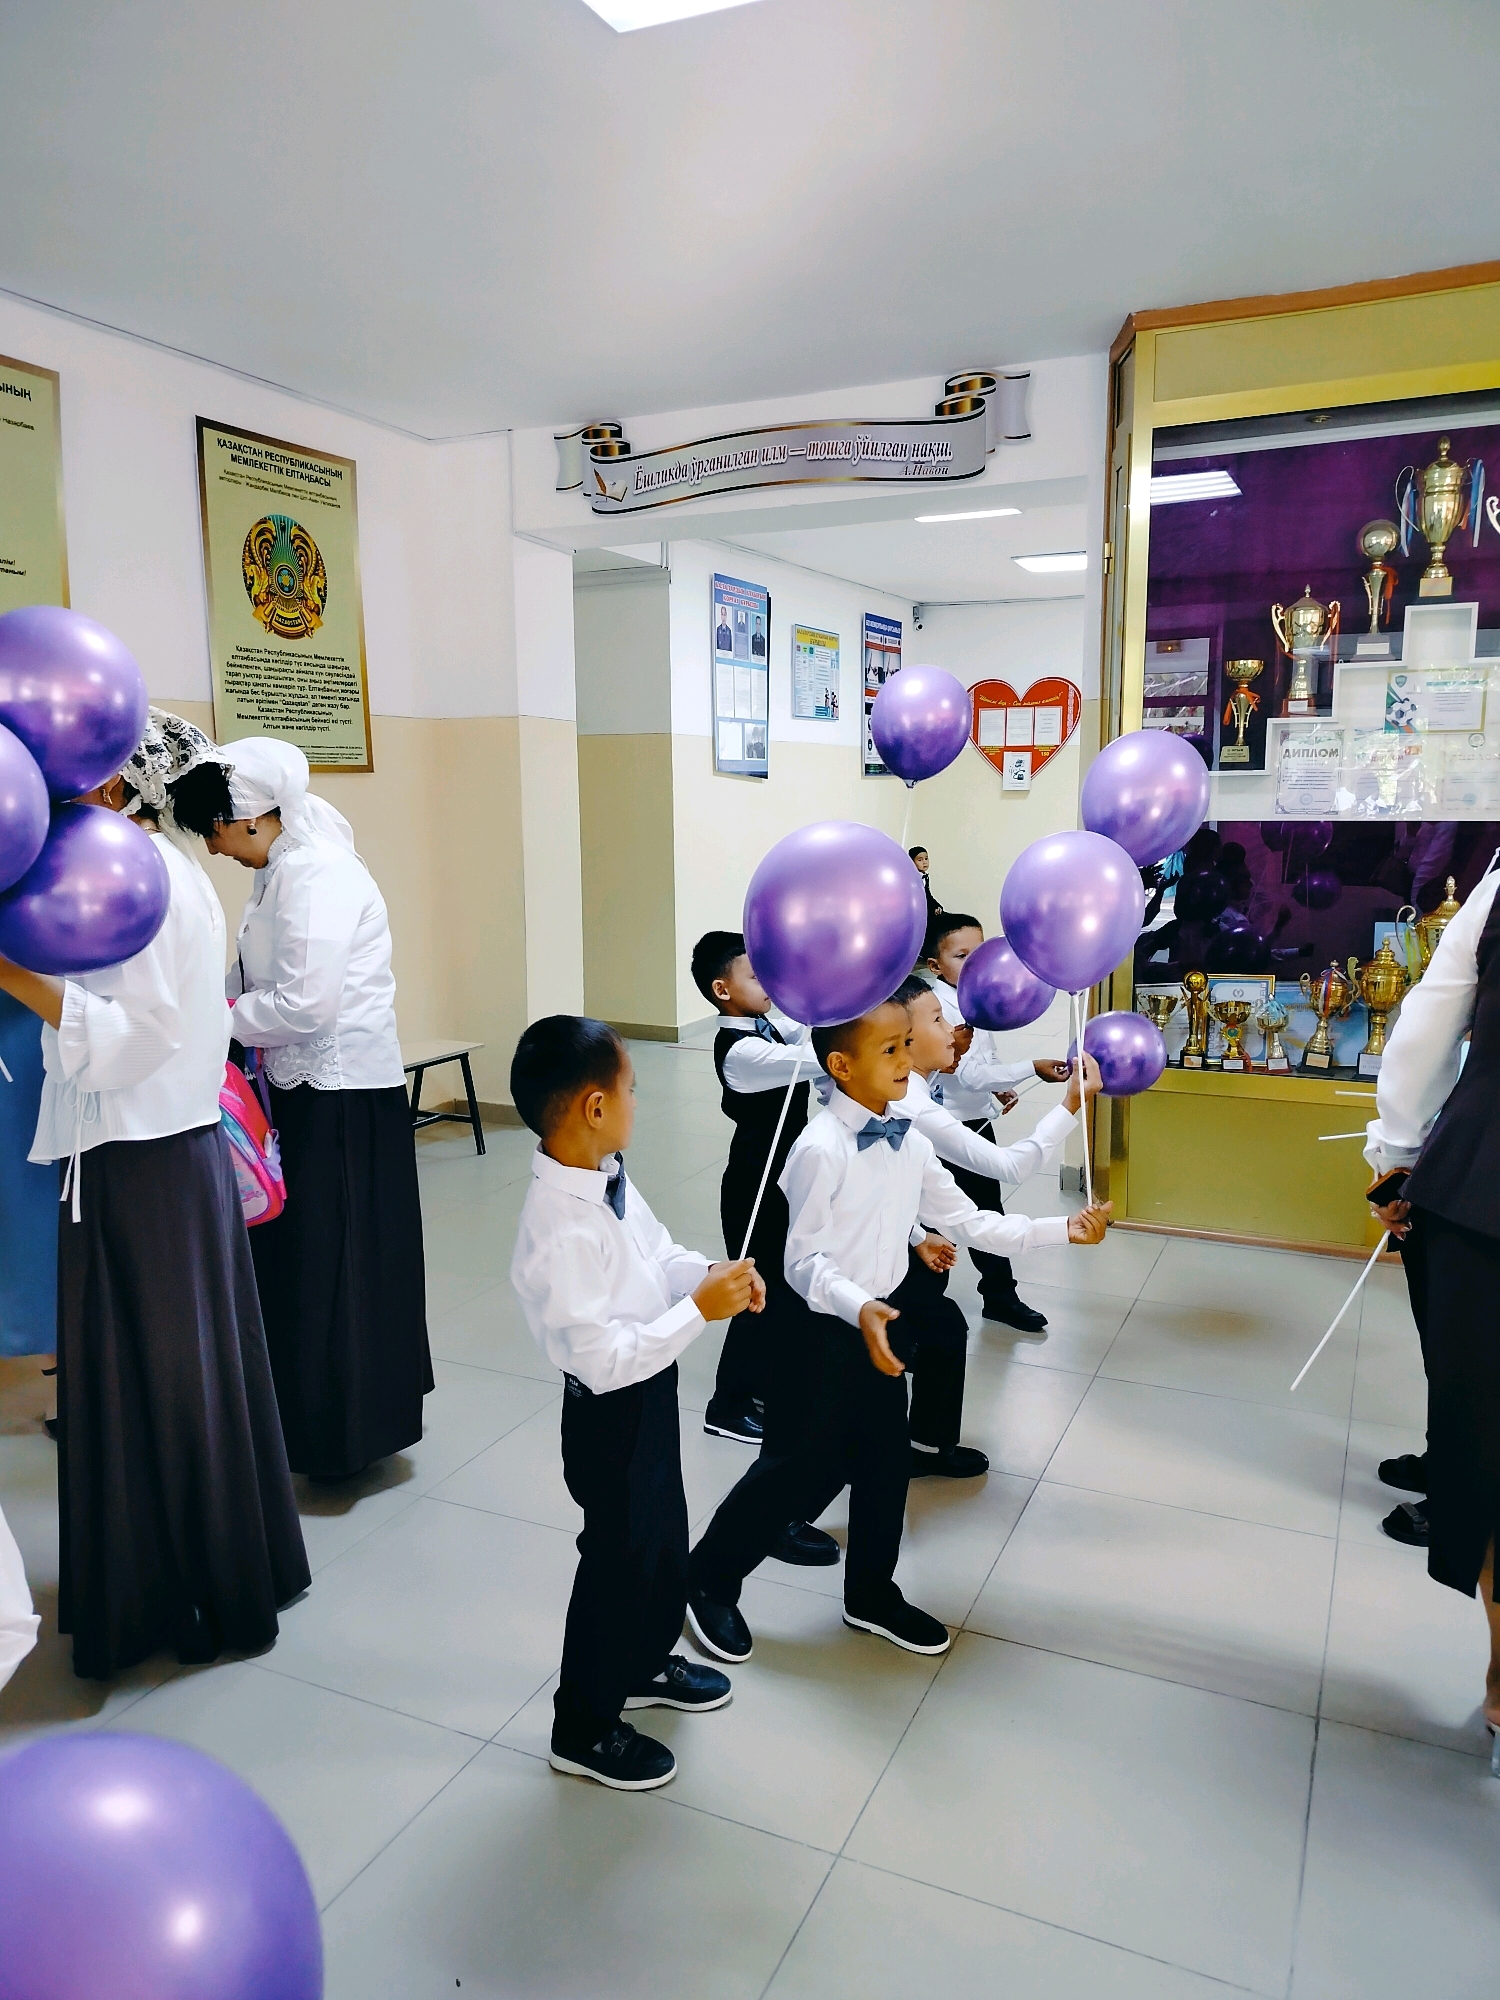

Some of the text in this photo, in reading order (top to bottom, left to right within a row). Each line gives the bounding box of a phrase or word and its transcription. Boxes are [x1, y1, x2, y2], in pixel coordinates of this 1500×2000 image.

[217, 438, 343, 481] ҚАЗАҚСТАН РЕСПУБЛИКАСЫНЫҢ
[230, 453, 331, 488] МЕМЛЕКЕТТІК ЕЛТАҢБАСЫ
[635, 459, 688, 490] Ёшликда
[690, 449, 759, 481] ўрганилган
[761, 444, 787, 464] илм
[808, 440, 852, 458] тошга
[1282, 748, 1339, 759] ДИПЛОМ
